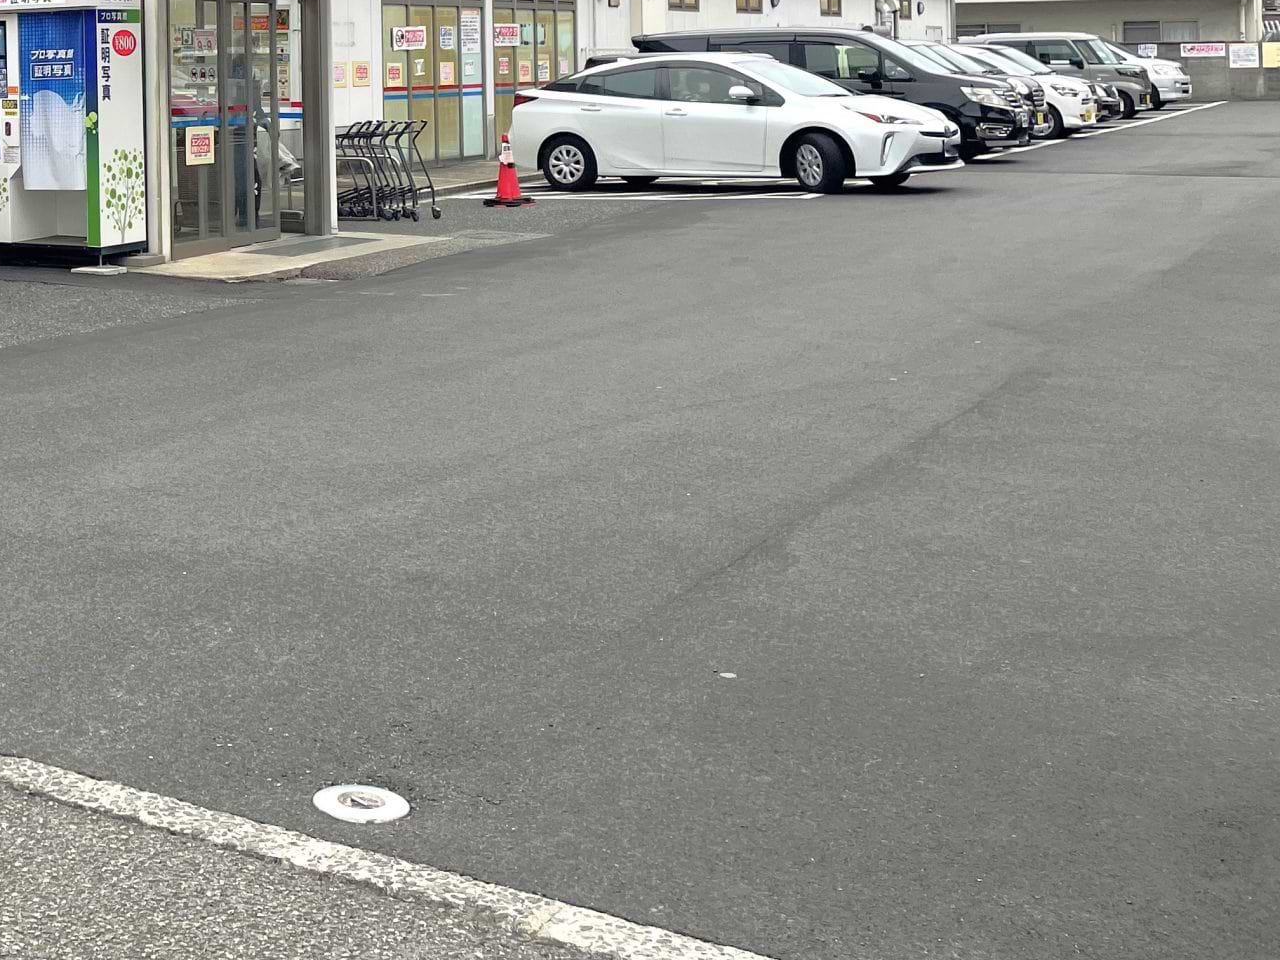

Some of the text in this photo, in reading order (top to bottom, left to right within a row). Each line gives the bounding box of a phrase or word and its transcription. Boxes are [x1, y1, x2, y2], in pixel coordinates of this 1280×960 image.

[34, 65, 72, 78] 証明写真
[101, 28, 112, 102] 証明写真
